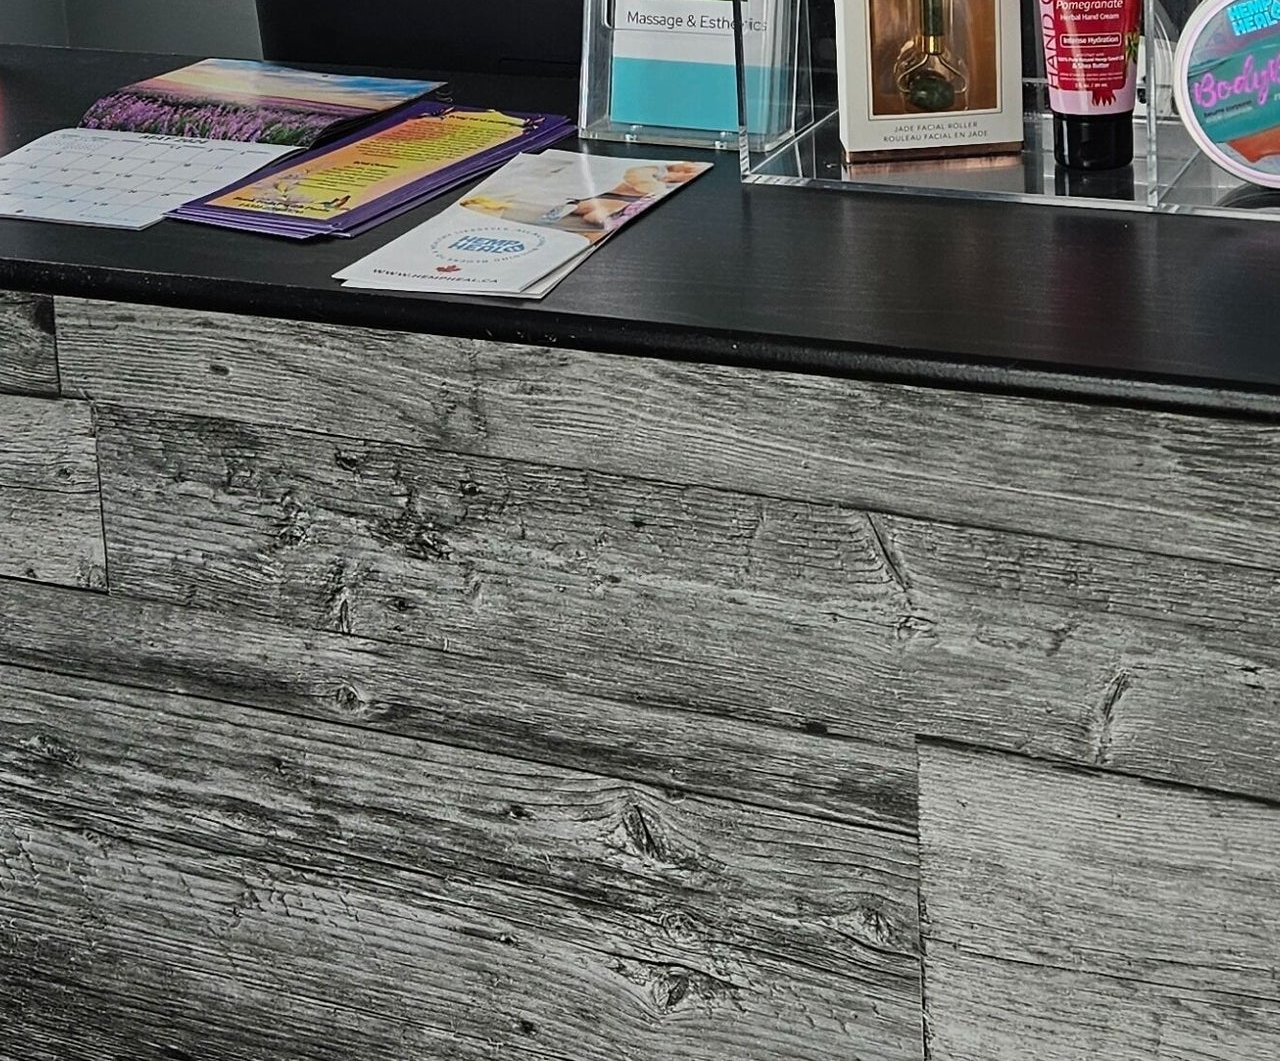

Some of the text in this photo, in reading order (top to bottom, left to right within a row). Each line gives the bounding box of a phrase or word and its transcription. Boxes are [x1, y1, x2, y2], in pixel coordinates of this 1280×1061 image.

[627, 10, 768, 32] Massage & Esthics
[1100, 12, 1120, 20] Cream
[1232, 11, 1278, 36] HEAL
[1087, 36, 1119, 45] Hydration
[1042, 14, 1060, 91] HAND
[917, 123, 946, 132] FACIAL
[948, 121, 978, 130] ROLLER
[884, 134, 921, 143] ROULEAU
[924, 132, 952, 140] FACIAL
[968, 130, 988, 138] JADE
[453, 235, 521, 247] HEMP
[448, 242, 506, 254] HEAL
